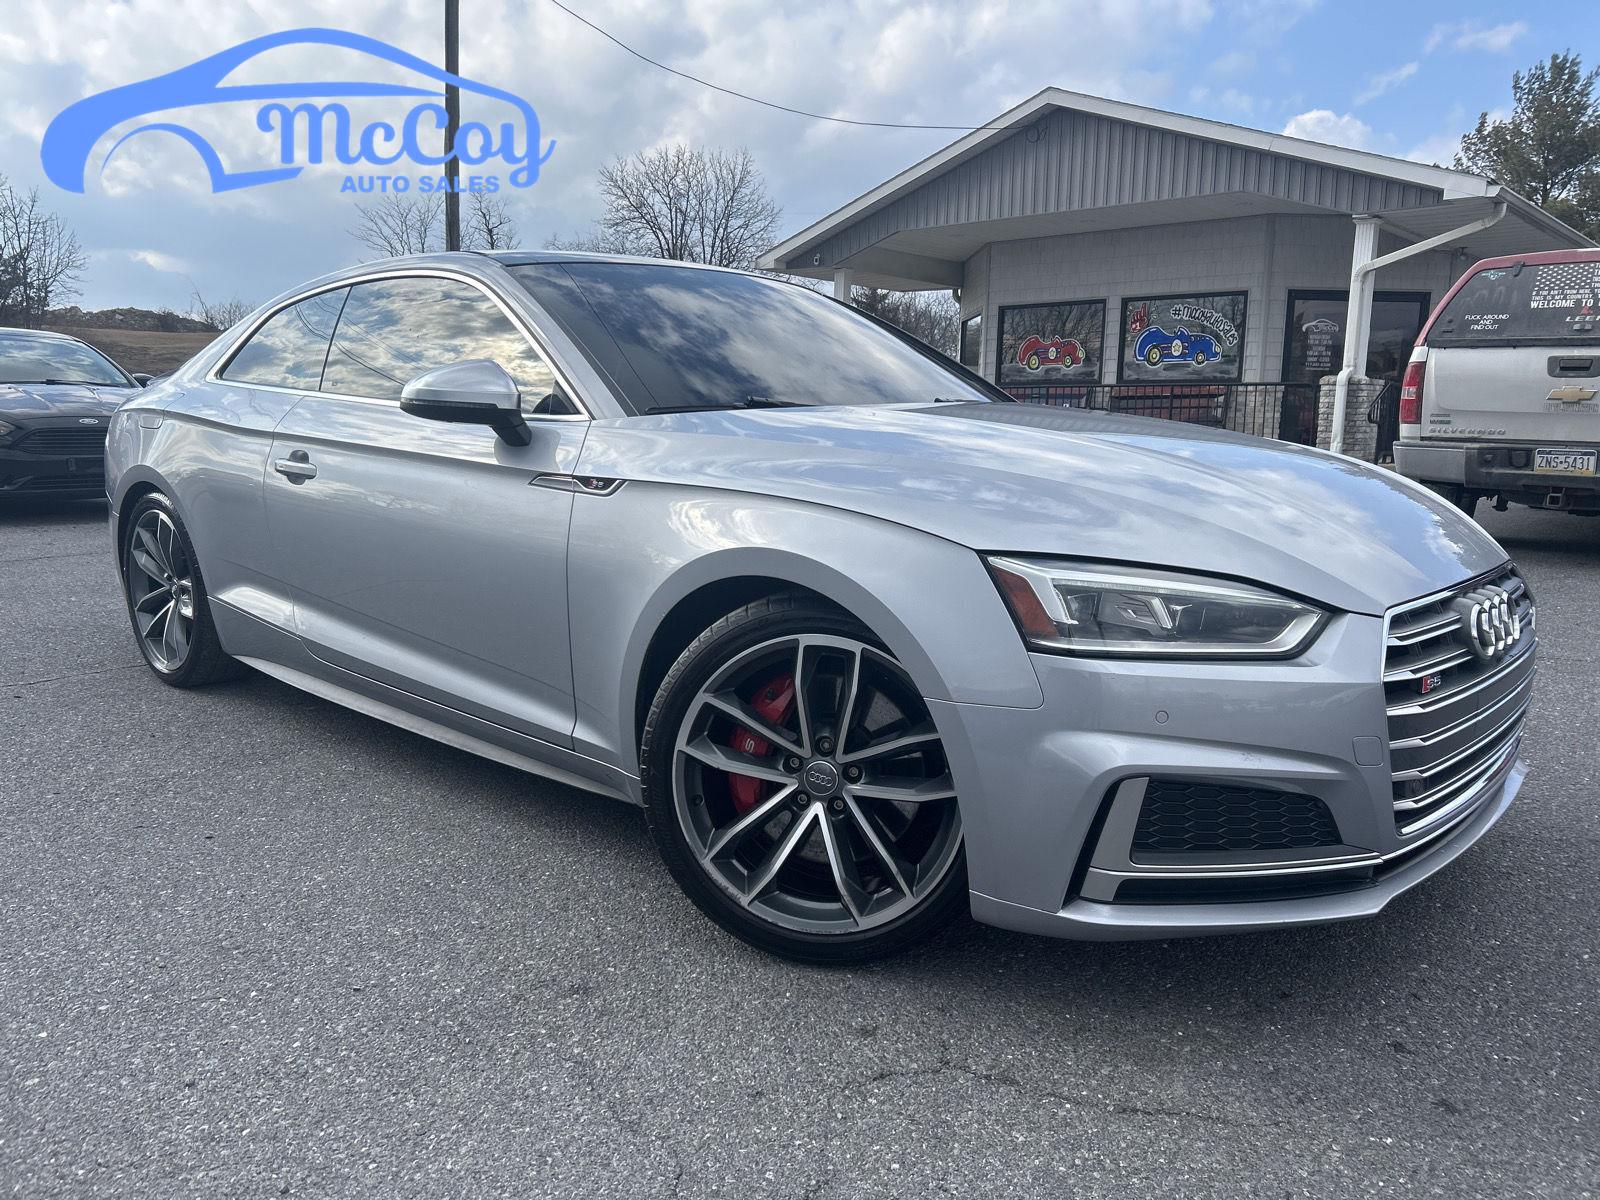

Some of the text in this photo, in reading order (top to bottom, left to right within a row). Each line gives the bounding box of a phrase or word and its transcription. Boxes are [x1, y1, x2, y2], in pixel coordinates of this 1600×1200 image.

[1530, 300, 1576, 309] WELCOME
[1581, 299, 1594, 307] TO
[1429, 427, 1506, 436] SILVERADO
